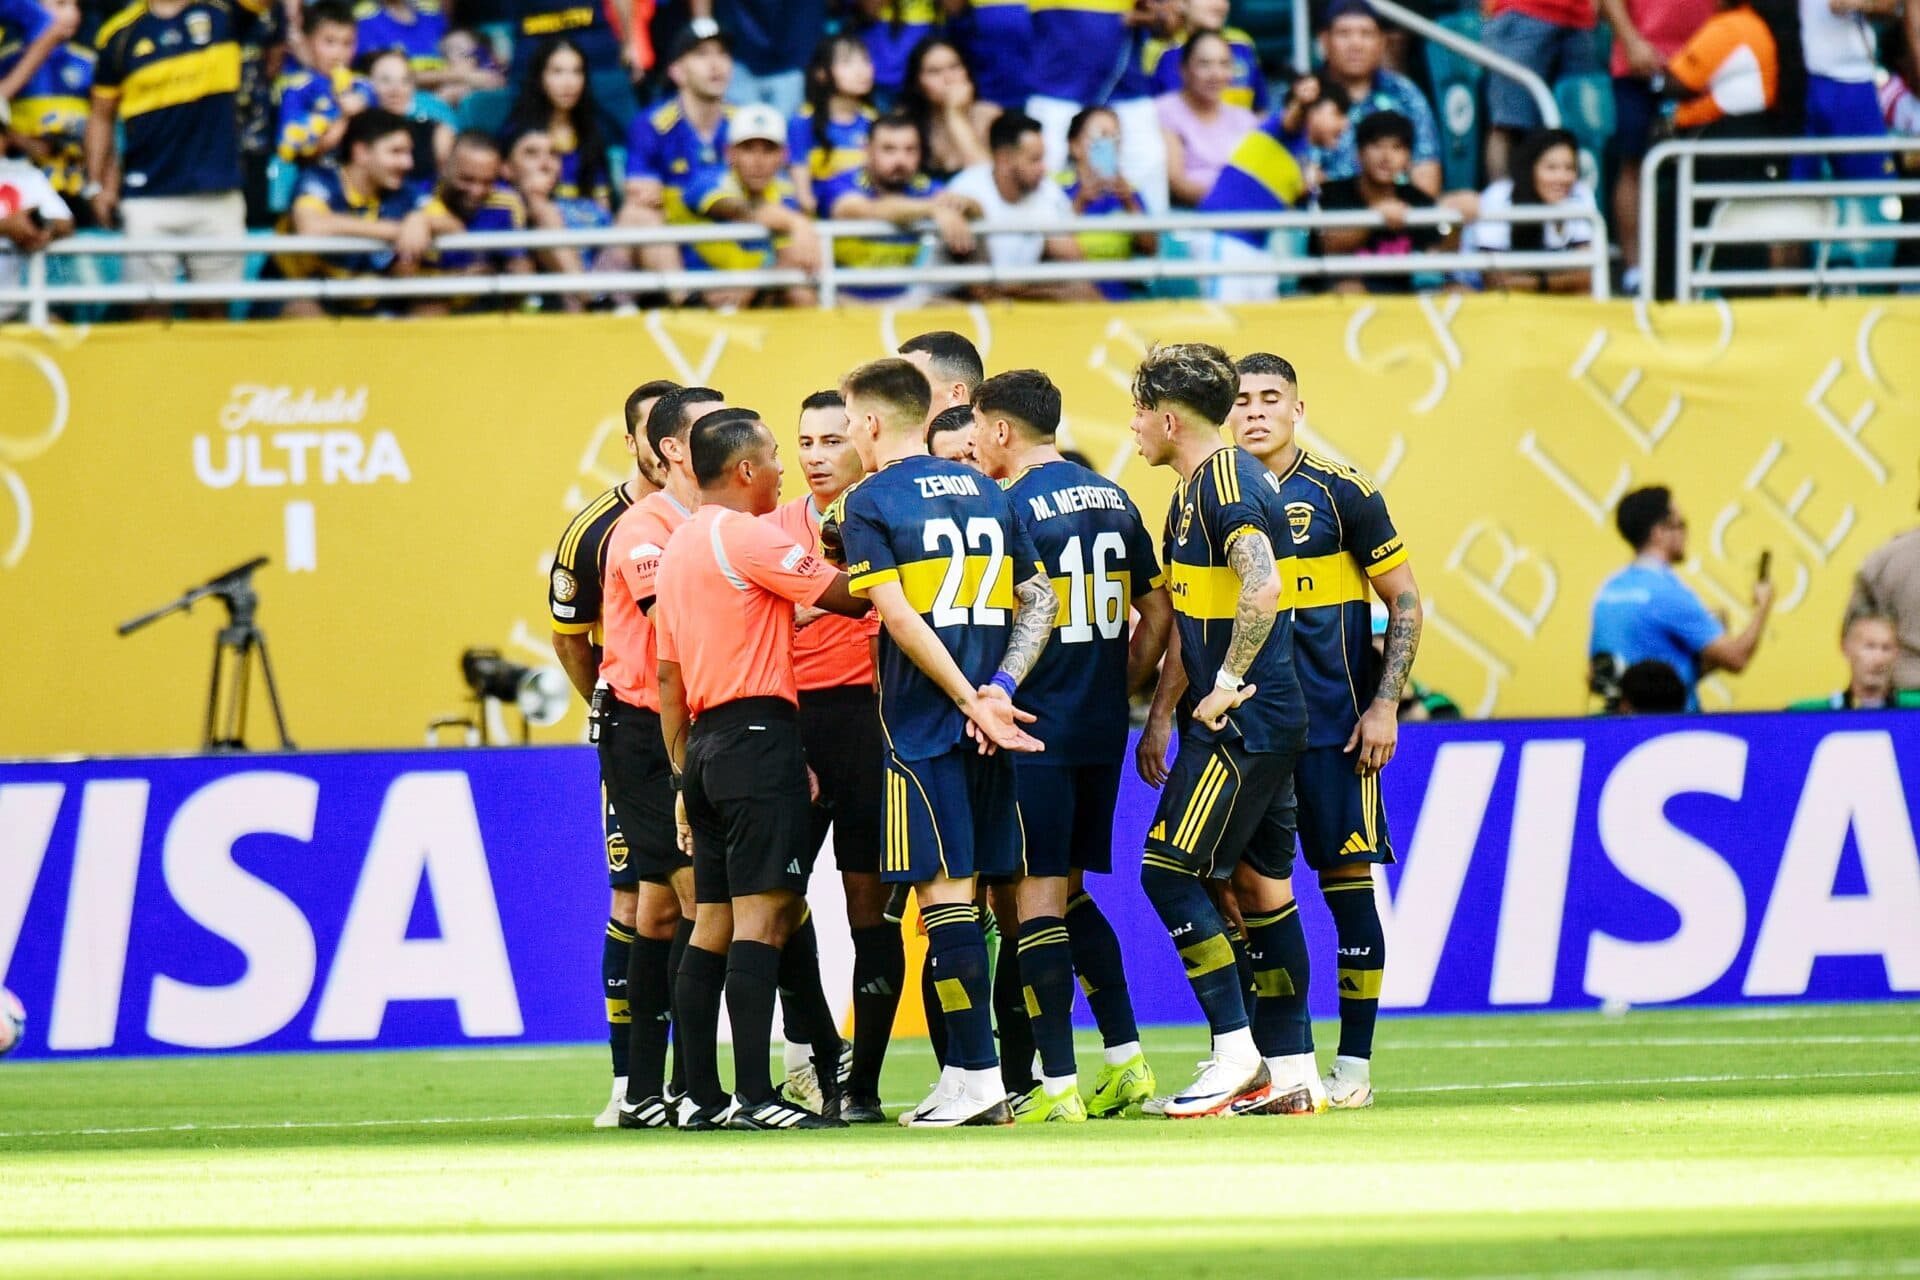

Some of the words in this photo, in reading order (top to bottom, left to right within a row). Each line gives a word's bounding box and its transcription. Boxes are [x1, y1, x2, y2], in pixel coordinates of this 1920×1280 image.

[193, 428, 411, 488] ULTRA
[914, 475, 980, 498] ZENON
[1028, 495, 1057, 521] M.
[636, 559, 659, 574] FIFA
[797, 555, 815, 574] FIFA
[922, 516, 1005, 628] 22
[1058, 531, 1127, 644] 16
[1374, 729, 1920, 1008] VISA
